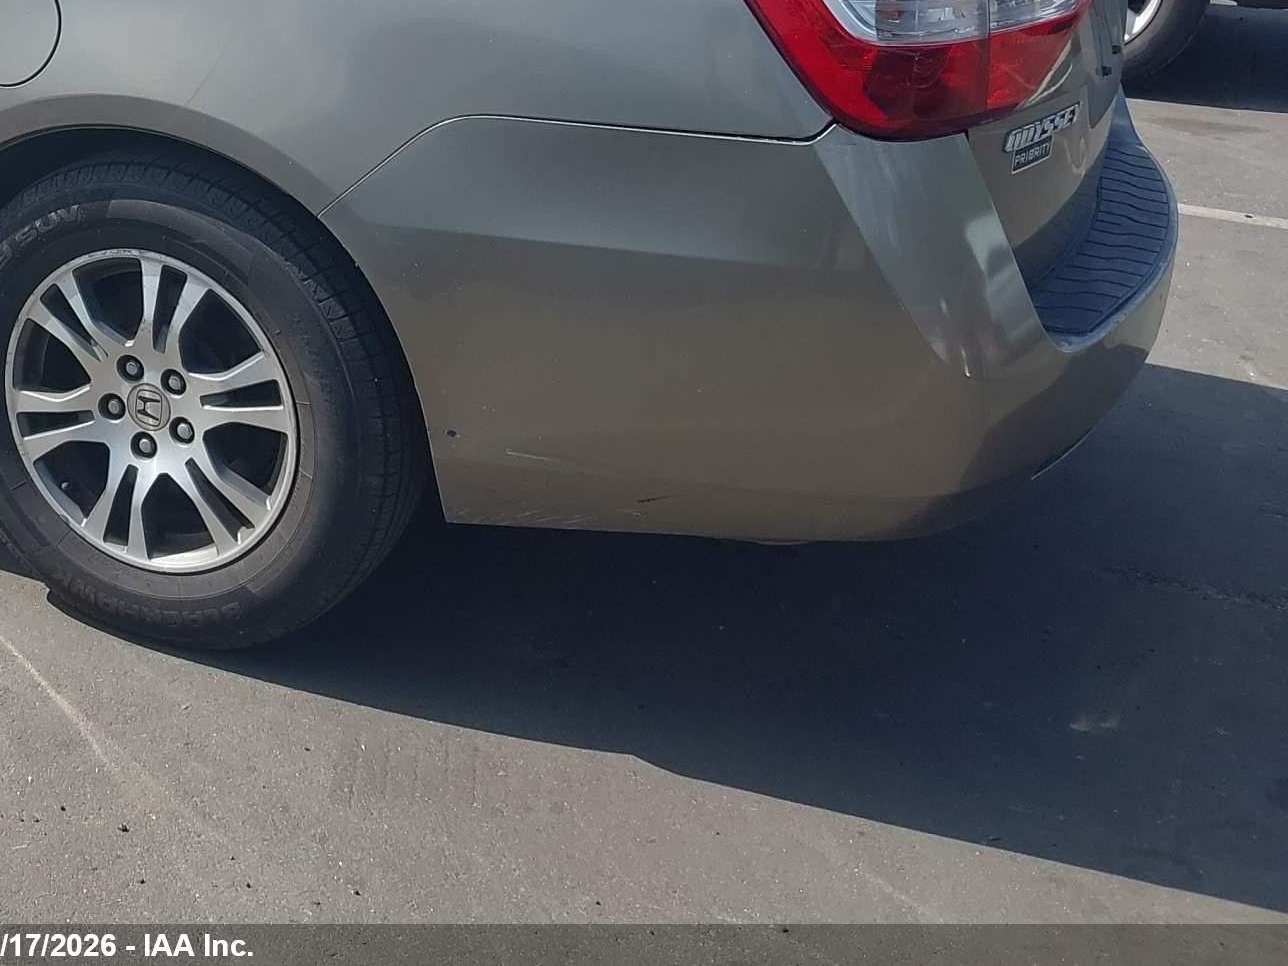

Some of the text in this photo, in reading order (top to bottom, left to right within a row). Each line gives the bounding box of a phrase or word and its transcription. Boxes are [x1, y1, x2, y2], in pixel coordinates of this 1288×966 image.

[1004, 104, 1080, 153] ODYSSEY
[1014, 143, 1050, 167] PRIORITY
[15, 205, 83, 247] SUV
